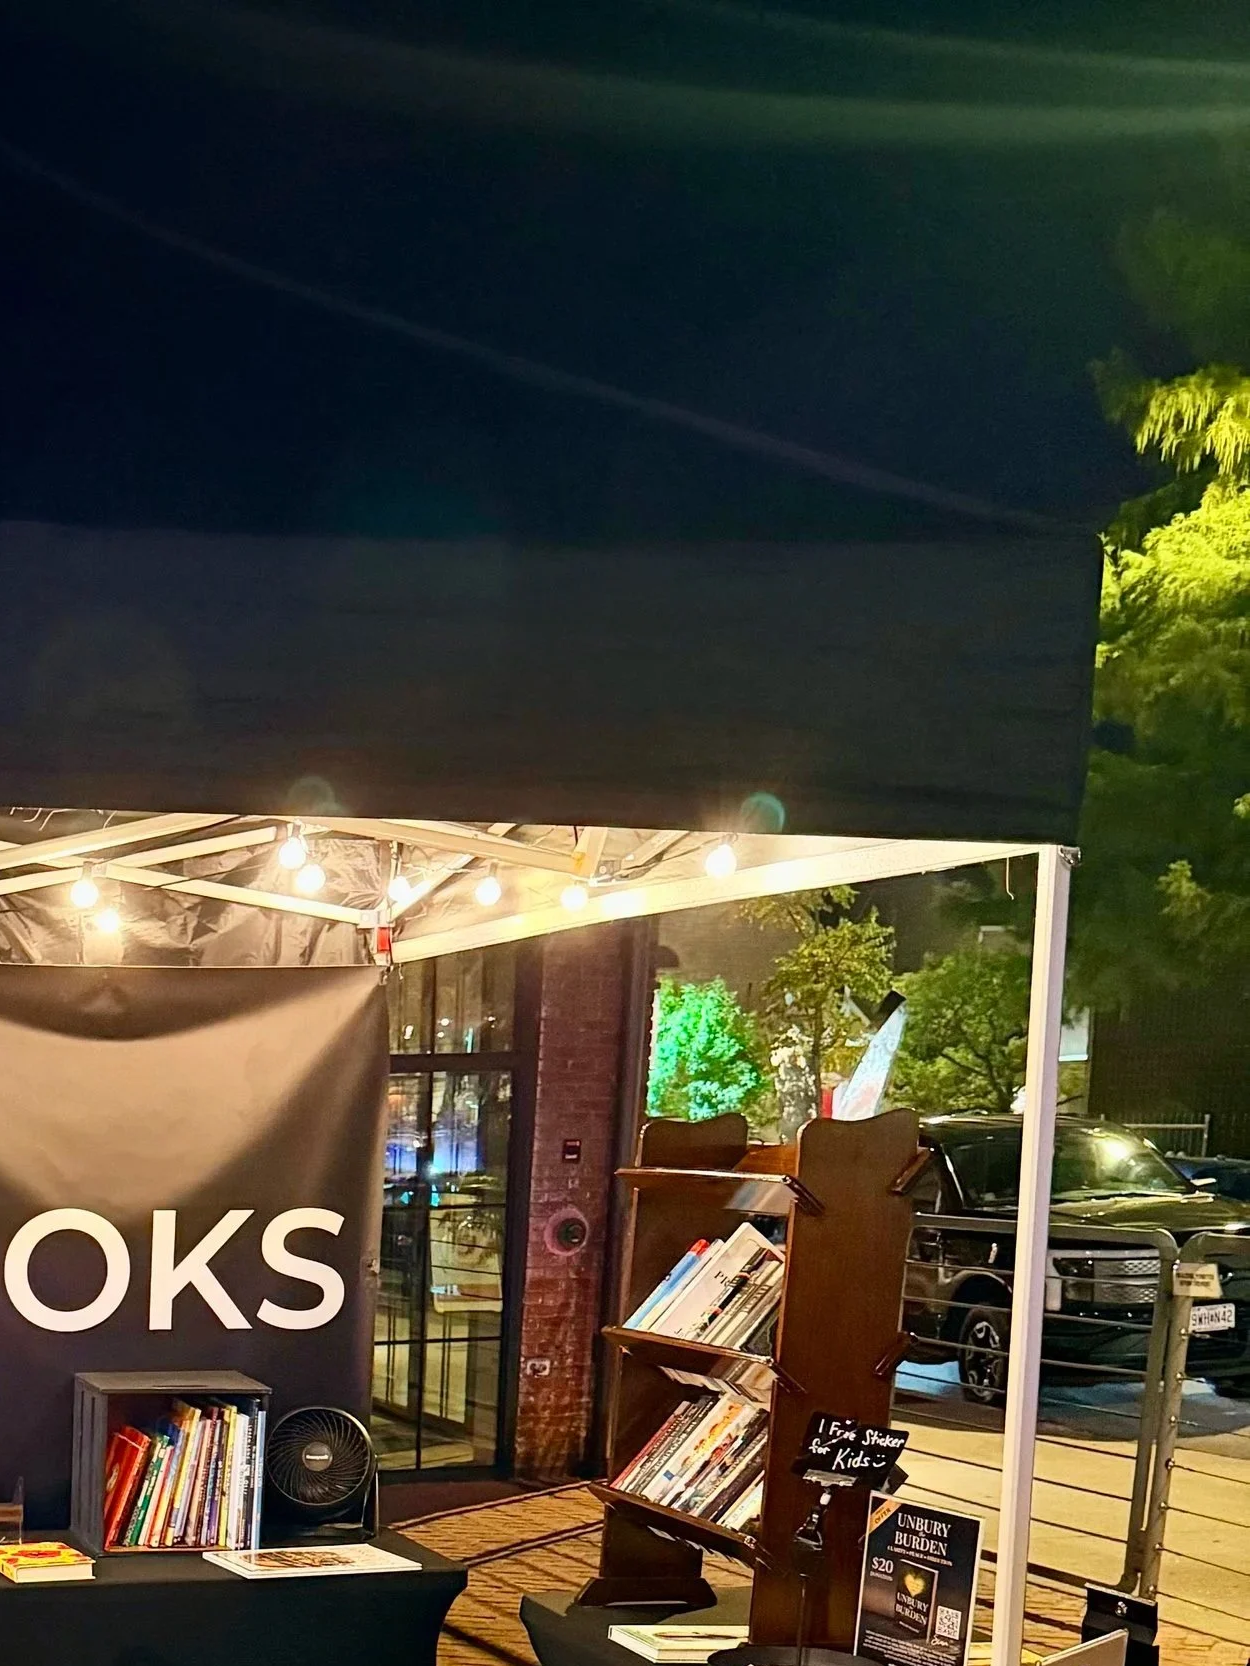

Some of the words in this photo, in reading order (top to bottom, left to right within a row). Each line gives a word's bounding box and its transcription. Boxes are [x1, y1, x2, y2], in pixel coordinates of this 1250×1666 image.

[862, 1429, 905, 1448] Sticker
[808, 1438, 830, 1455] for
[832, 1448, 870, 1470] Kids
[897, 1513, 951, 1538] UNBURY
[894, 1531, 948, 1556] BURDEN
[871, 1556, 894, 1574] $20
[896, 1592, 929, 1613] UNBURY
[895, 1603, 927, 1626] BURDEN
